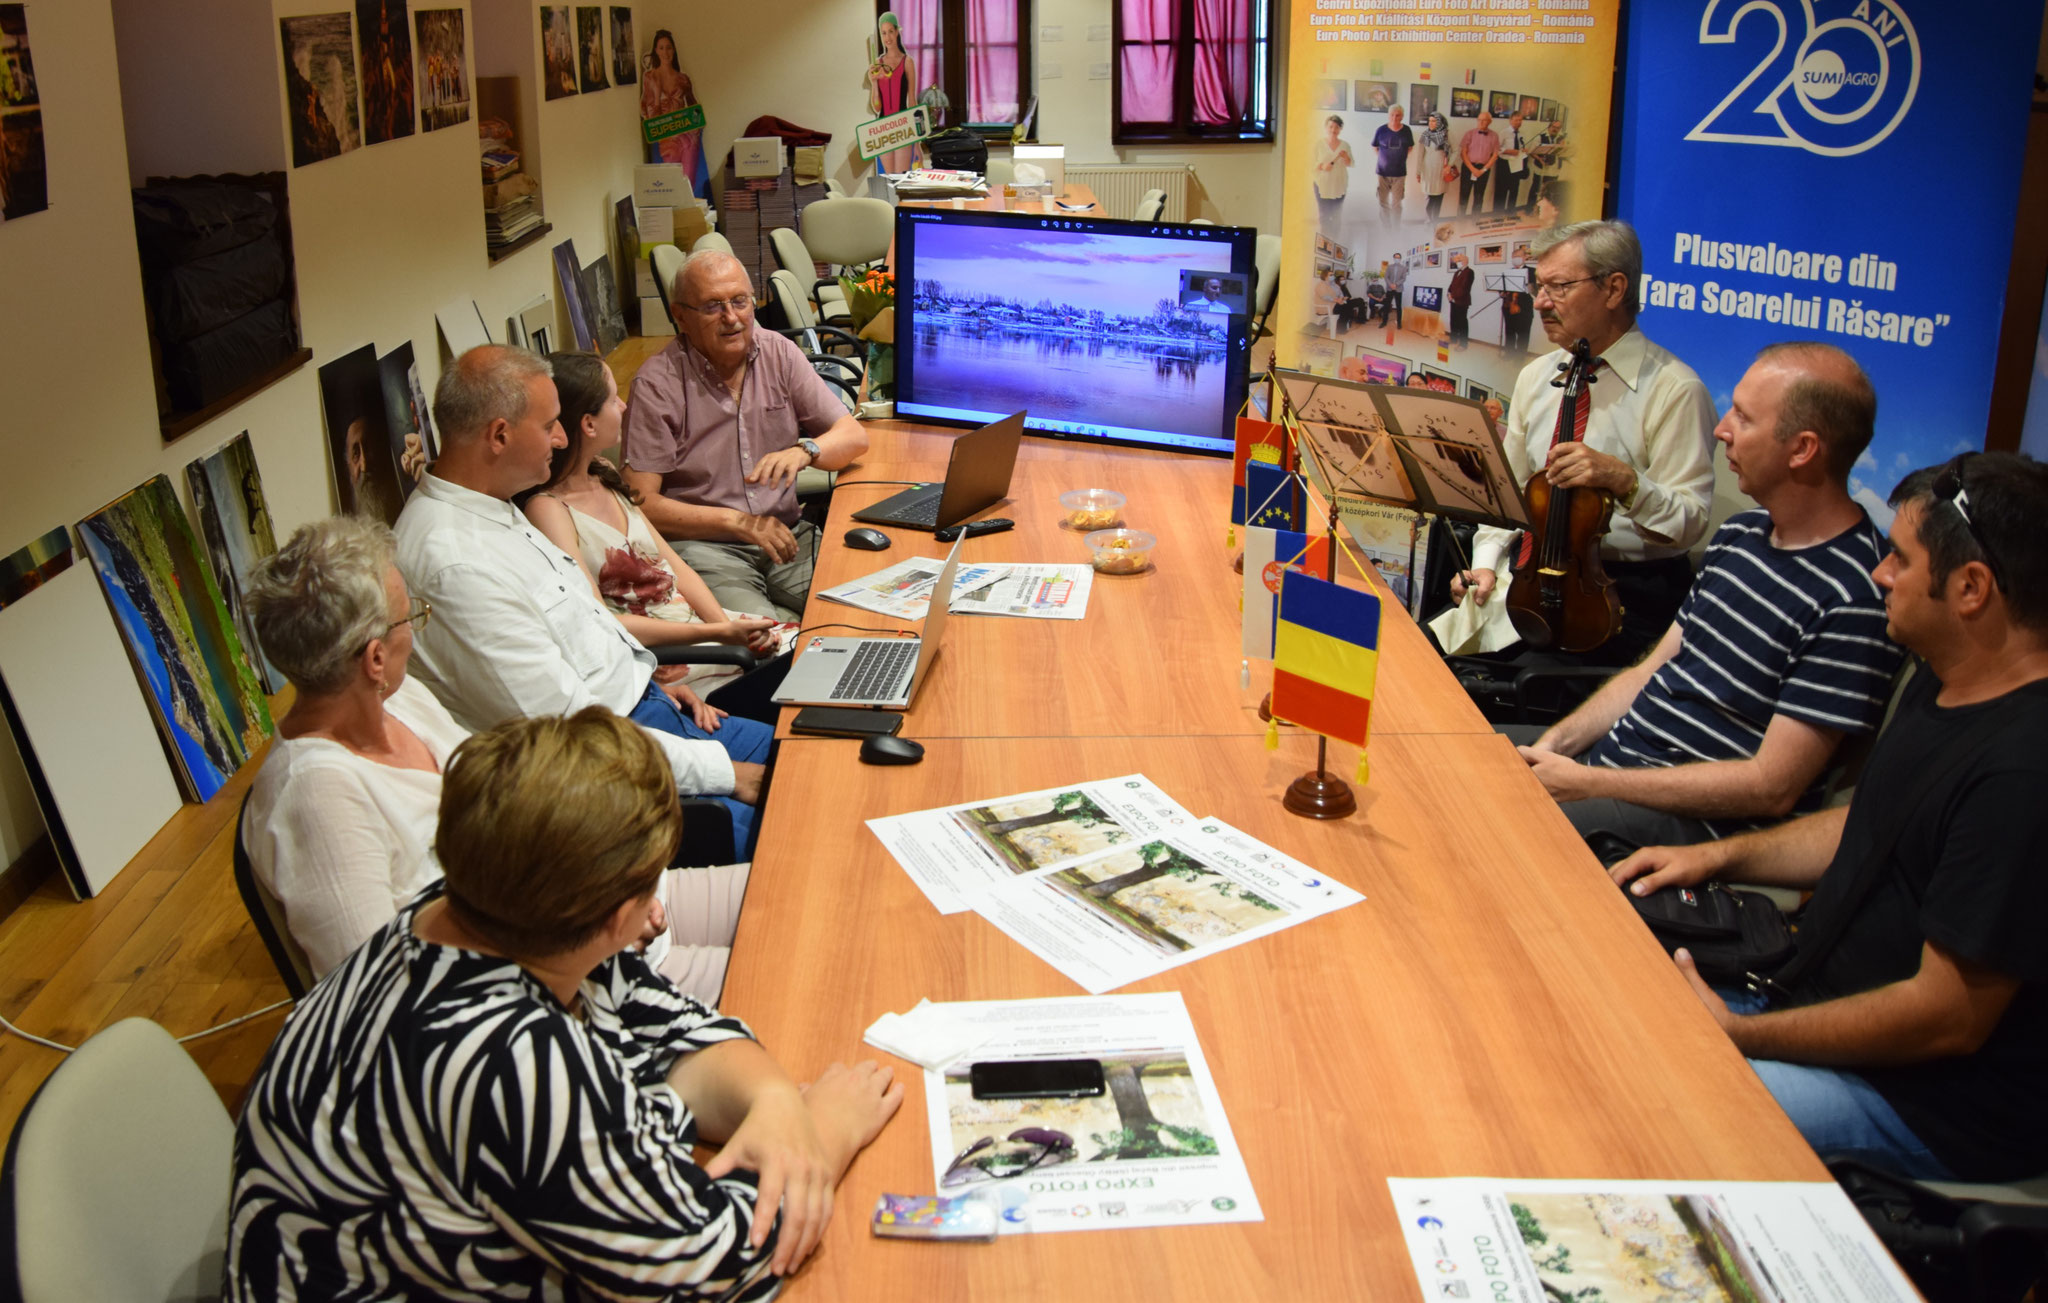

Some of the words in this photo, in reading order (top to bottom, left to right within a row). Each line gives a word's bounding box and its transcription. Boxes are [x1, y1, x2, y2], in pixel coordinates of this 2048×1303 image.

[1419, 0, 1443, 9] Euro
[1445, 0, 1468, 9] Foto
[1470, 0, 1488, 9] Art
[1490, 0, 1529, 10] Oradea
[1310, 14, 1333, 26] Euro
[1335, 14, 1356, 26] Foto
[1358, 14, 1374, 26] Art
[1427, 13, 1470, 27] Központ
[1472, 14, 1532, 28] Nagyvárad
[1543, 14, 1594, 27] Románia
[1852, 0, 1905, 48] ANI
[1316, 30, 1338, 41] Euro
[1341, 30, 1370, 41] Photo
[1372, 30, 1389, 41] Art
[1391, 30, 1444, 42] Exhibition
[1446, 30, 1483, 42] Center
[1486, 31, 1526, 43] Oradea
[1534, 31, 1586, 44] Romania
[650, 118, 692, 138] SUPERIA
[868, 117, 908, 136] FUJICOLOR
[865, 127, 916, 153] SUPERIA
[1674, 232, 1842, 283] Plusvaloare
[1848, 253, 1897, 291] din
[1702, 281, 1821, 330] Soarelui
[1122, 804, 1148, 822] EXPO
[1144, 820, 1161, 832] FO
[1213, 851, 1247, 869] EXPO
[1246, 868, 1280, 887] FOTO
[1030, 1180, 1089, 1192] FOTO
[1096, 1177, 1155, 1189] EXPO
[1473, 1235, 1504, 1276] FOTO
